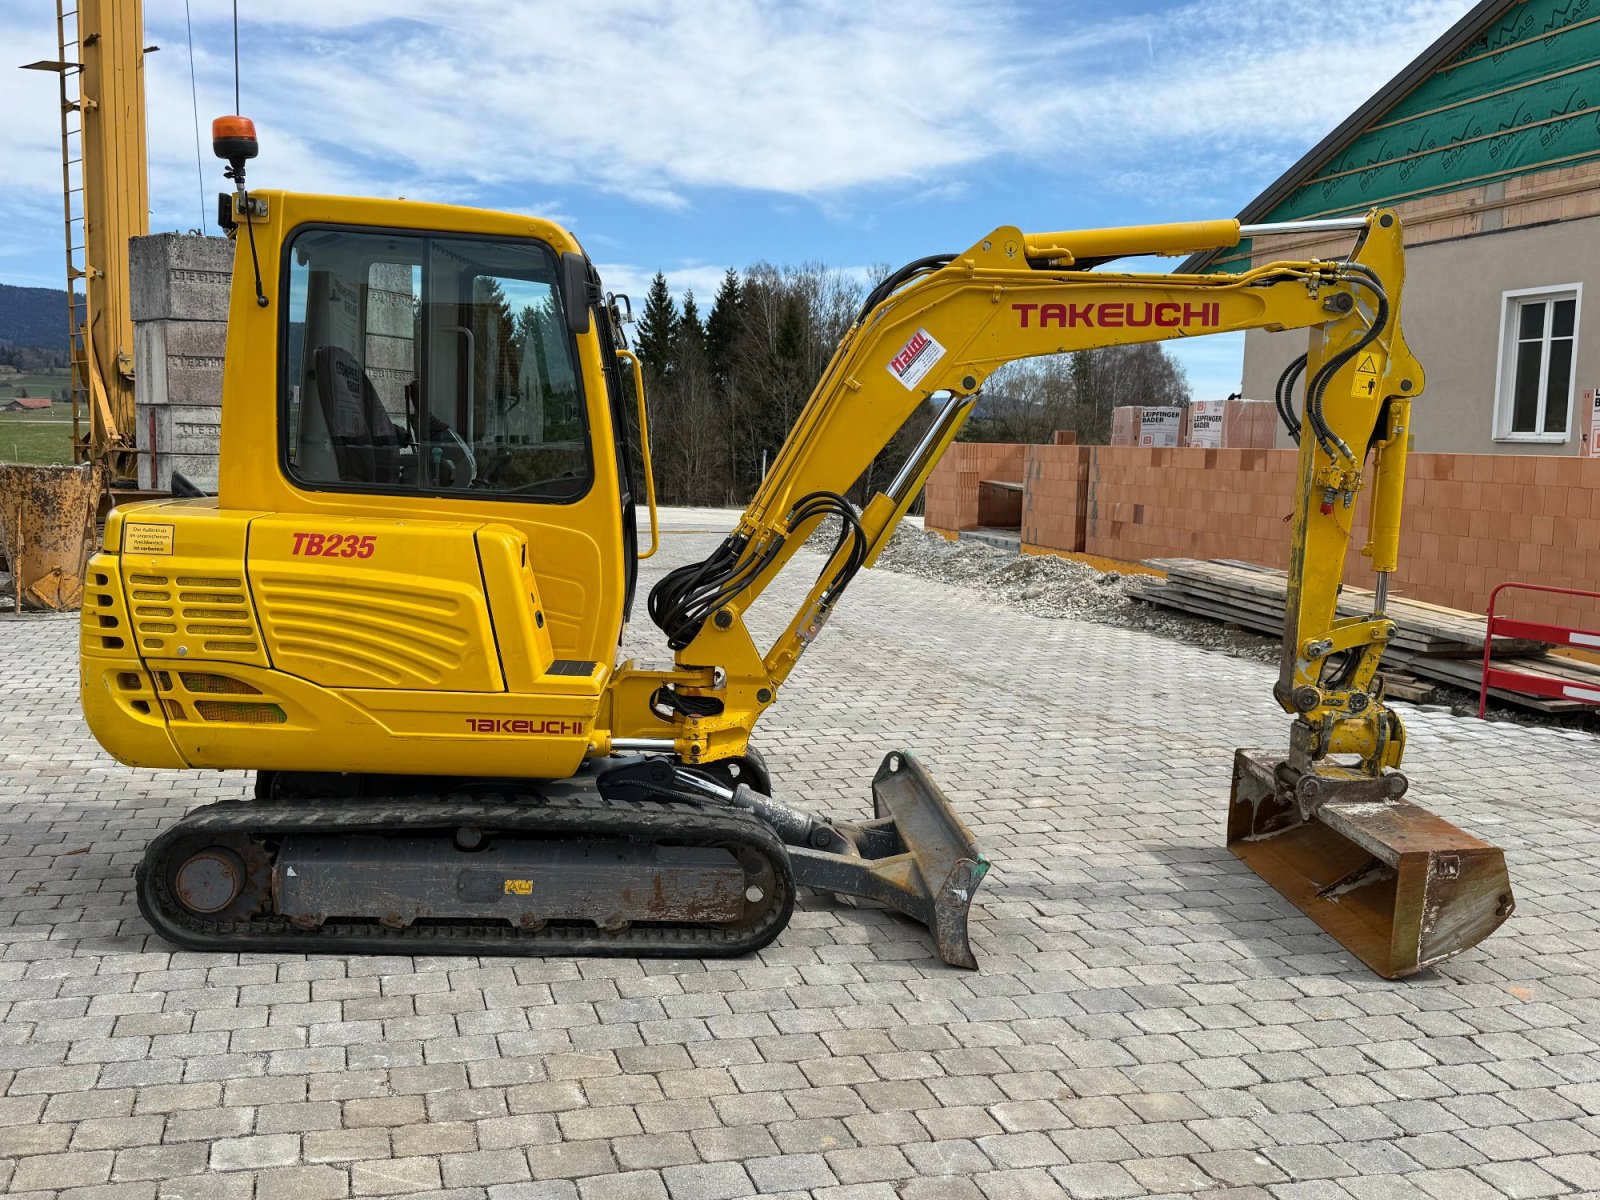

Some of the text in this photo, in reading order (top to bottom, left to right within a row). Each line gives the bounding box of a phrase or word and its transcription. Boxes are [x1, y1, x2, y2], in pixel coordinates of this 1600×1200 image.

[1011, 302, 1220, 328] TAKEUCHI
[1193, 415, 1222, 423] LEIPFINGER
[292, 532, 377, 559] TB235
[465, 718, 582, 735] TAKEUCHI
